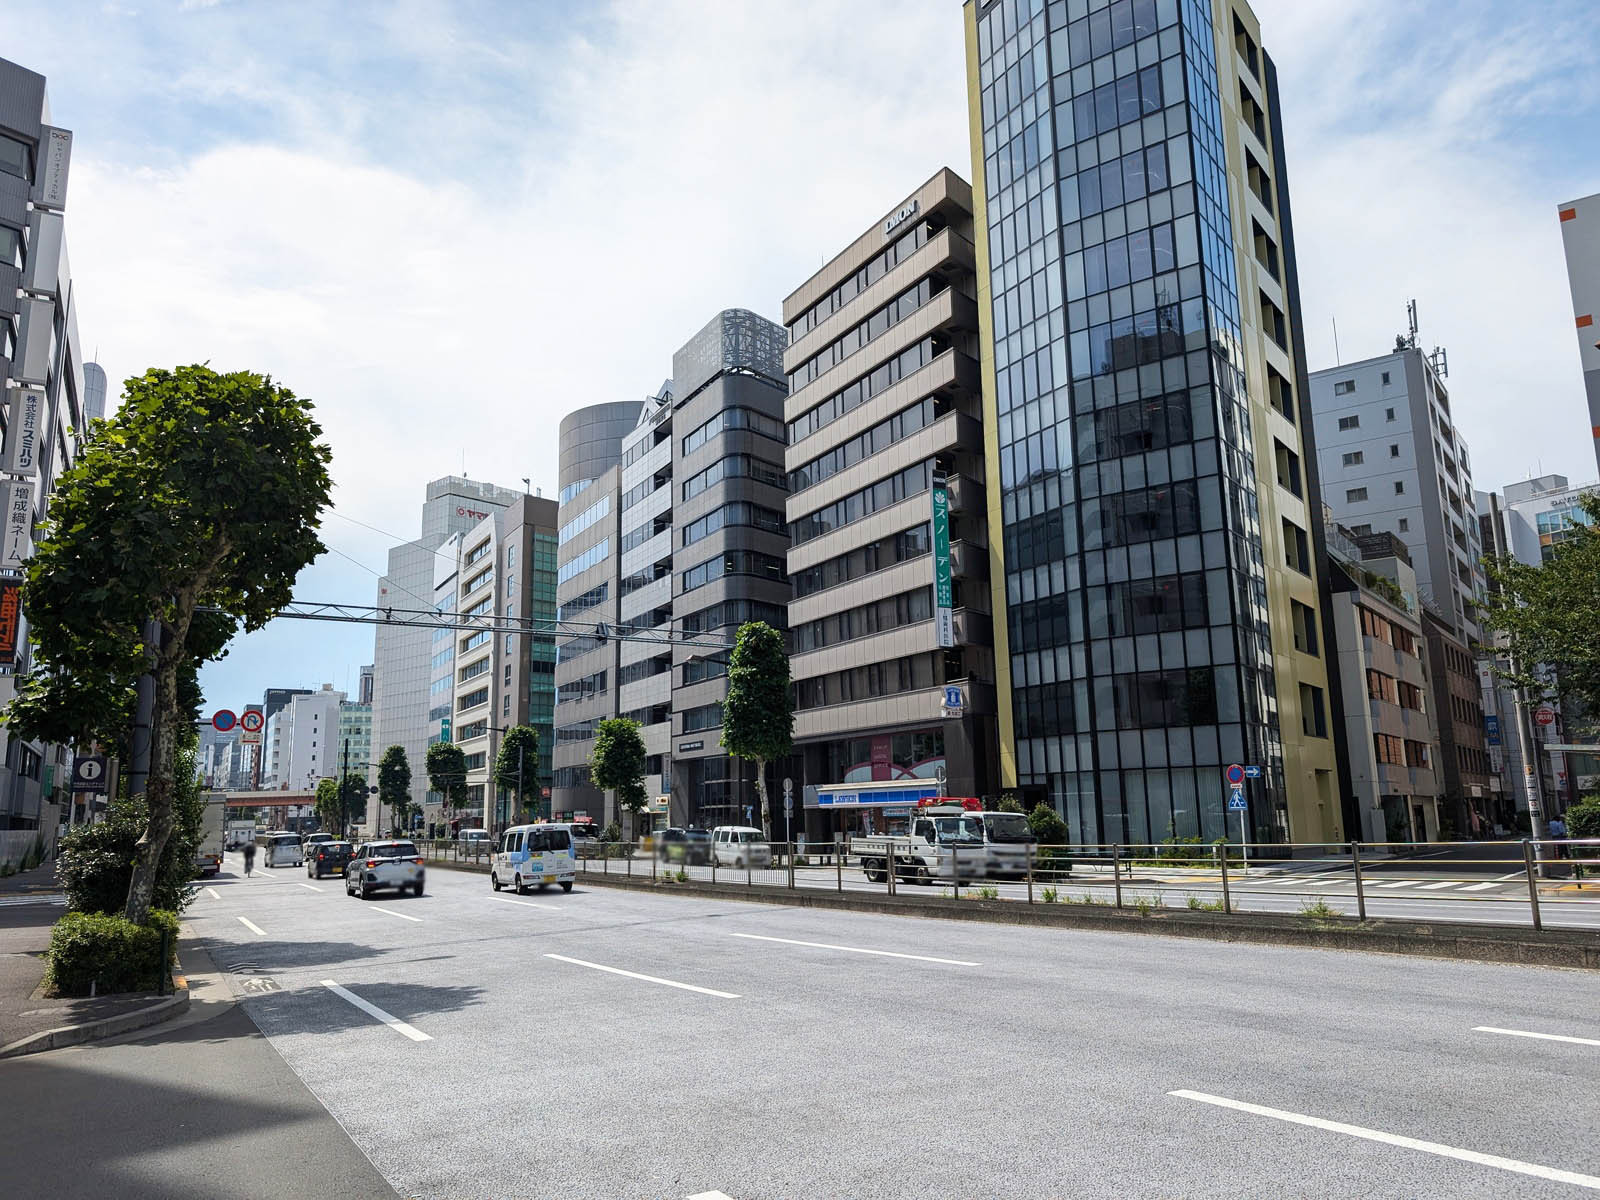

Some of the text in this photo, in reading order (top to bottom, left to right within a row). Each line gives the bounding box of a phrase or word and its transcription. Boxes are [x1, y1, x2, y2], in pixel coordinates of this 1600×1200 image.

[8, 487, 29, 561] 増成織ネーム
[935, 506, 949, 583] スノーデン
